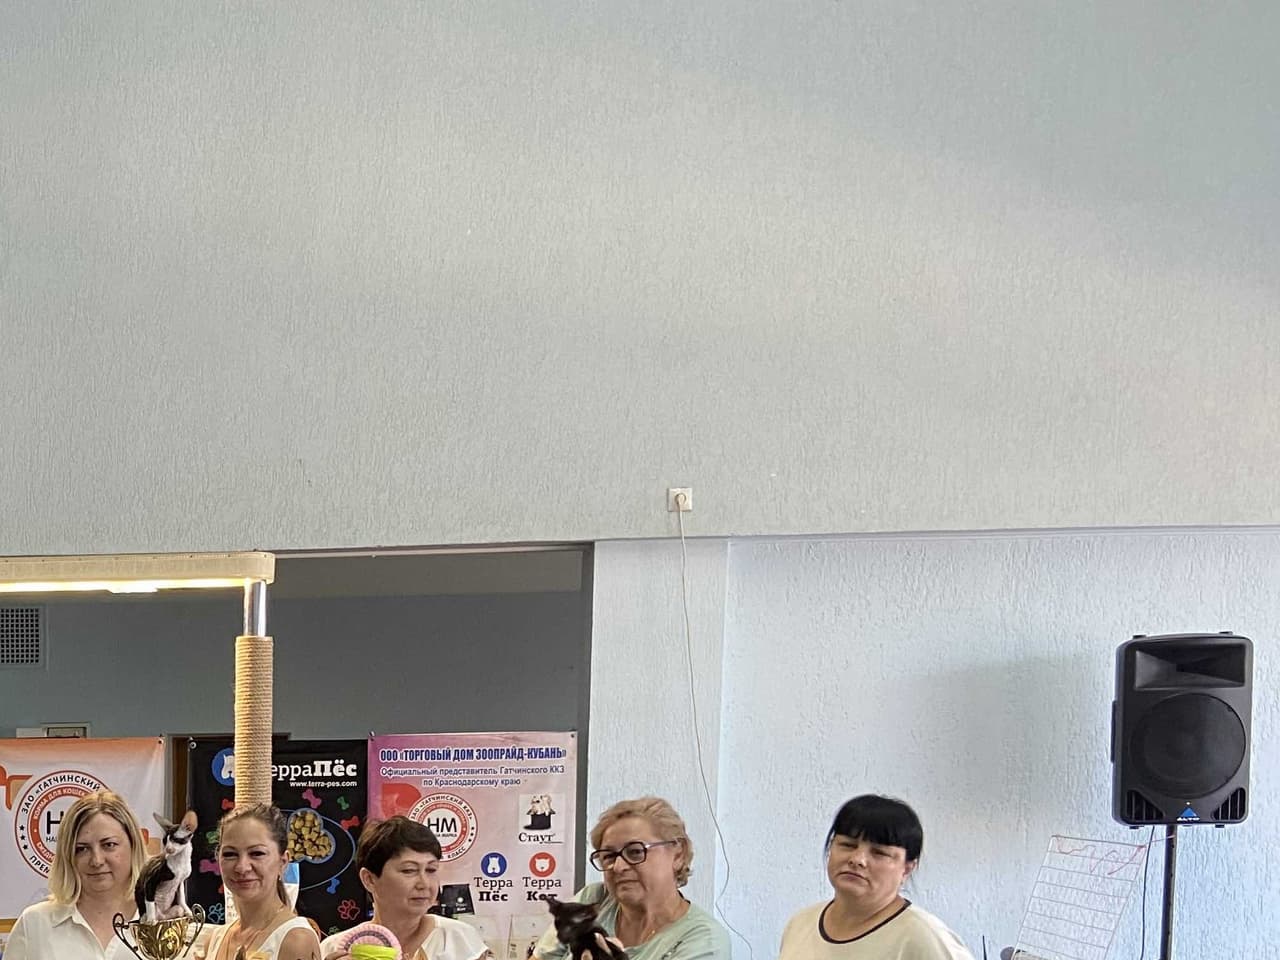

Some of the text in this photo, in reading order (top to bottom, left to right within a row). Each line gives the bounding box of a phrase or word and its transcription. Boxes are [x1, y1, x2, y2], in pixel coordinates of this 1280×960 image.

[380, 749, 398, 762] ООО
[453, 748, 474, 762] ДОМ
[271, 758, 358, 781] ерраПёс
[381, 766, 565, 777] Официальный представитель Гатчинского ККЗ
[434, 778, 499, 787] Краснодарскому
[500, 779, 521, 787] краю
[21, 795, 35, 814] ЗАО
[473, 876, 513, 889] Терра
[522, 876, 562, 889] Терра
[478, 890, 509, 901] Пёс
